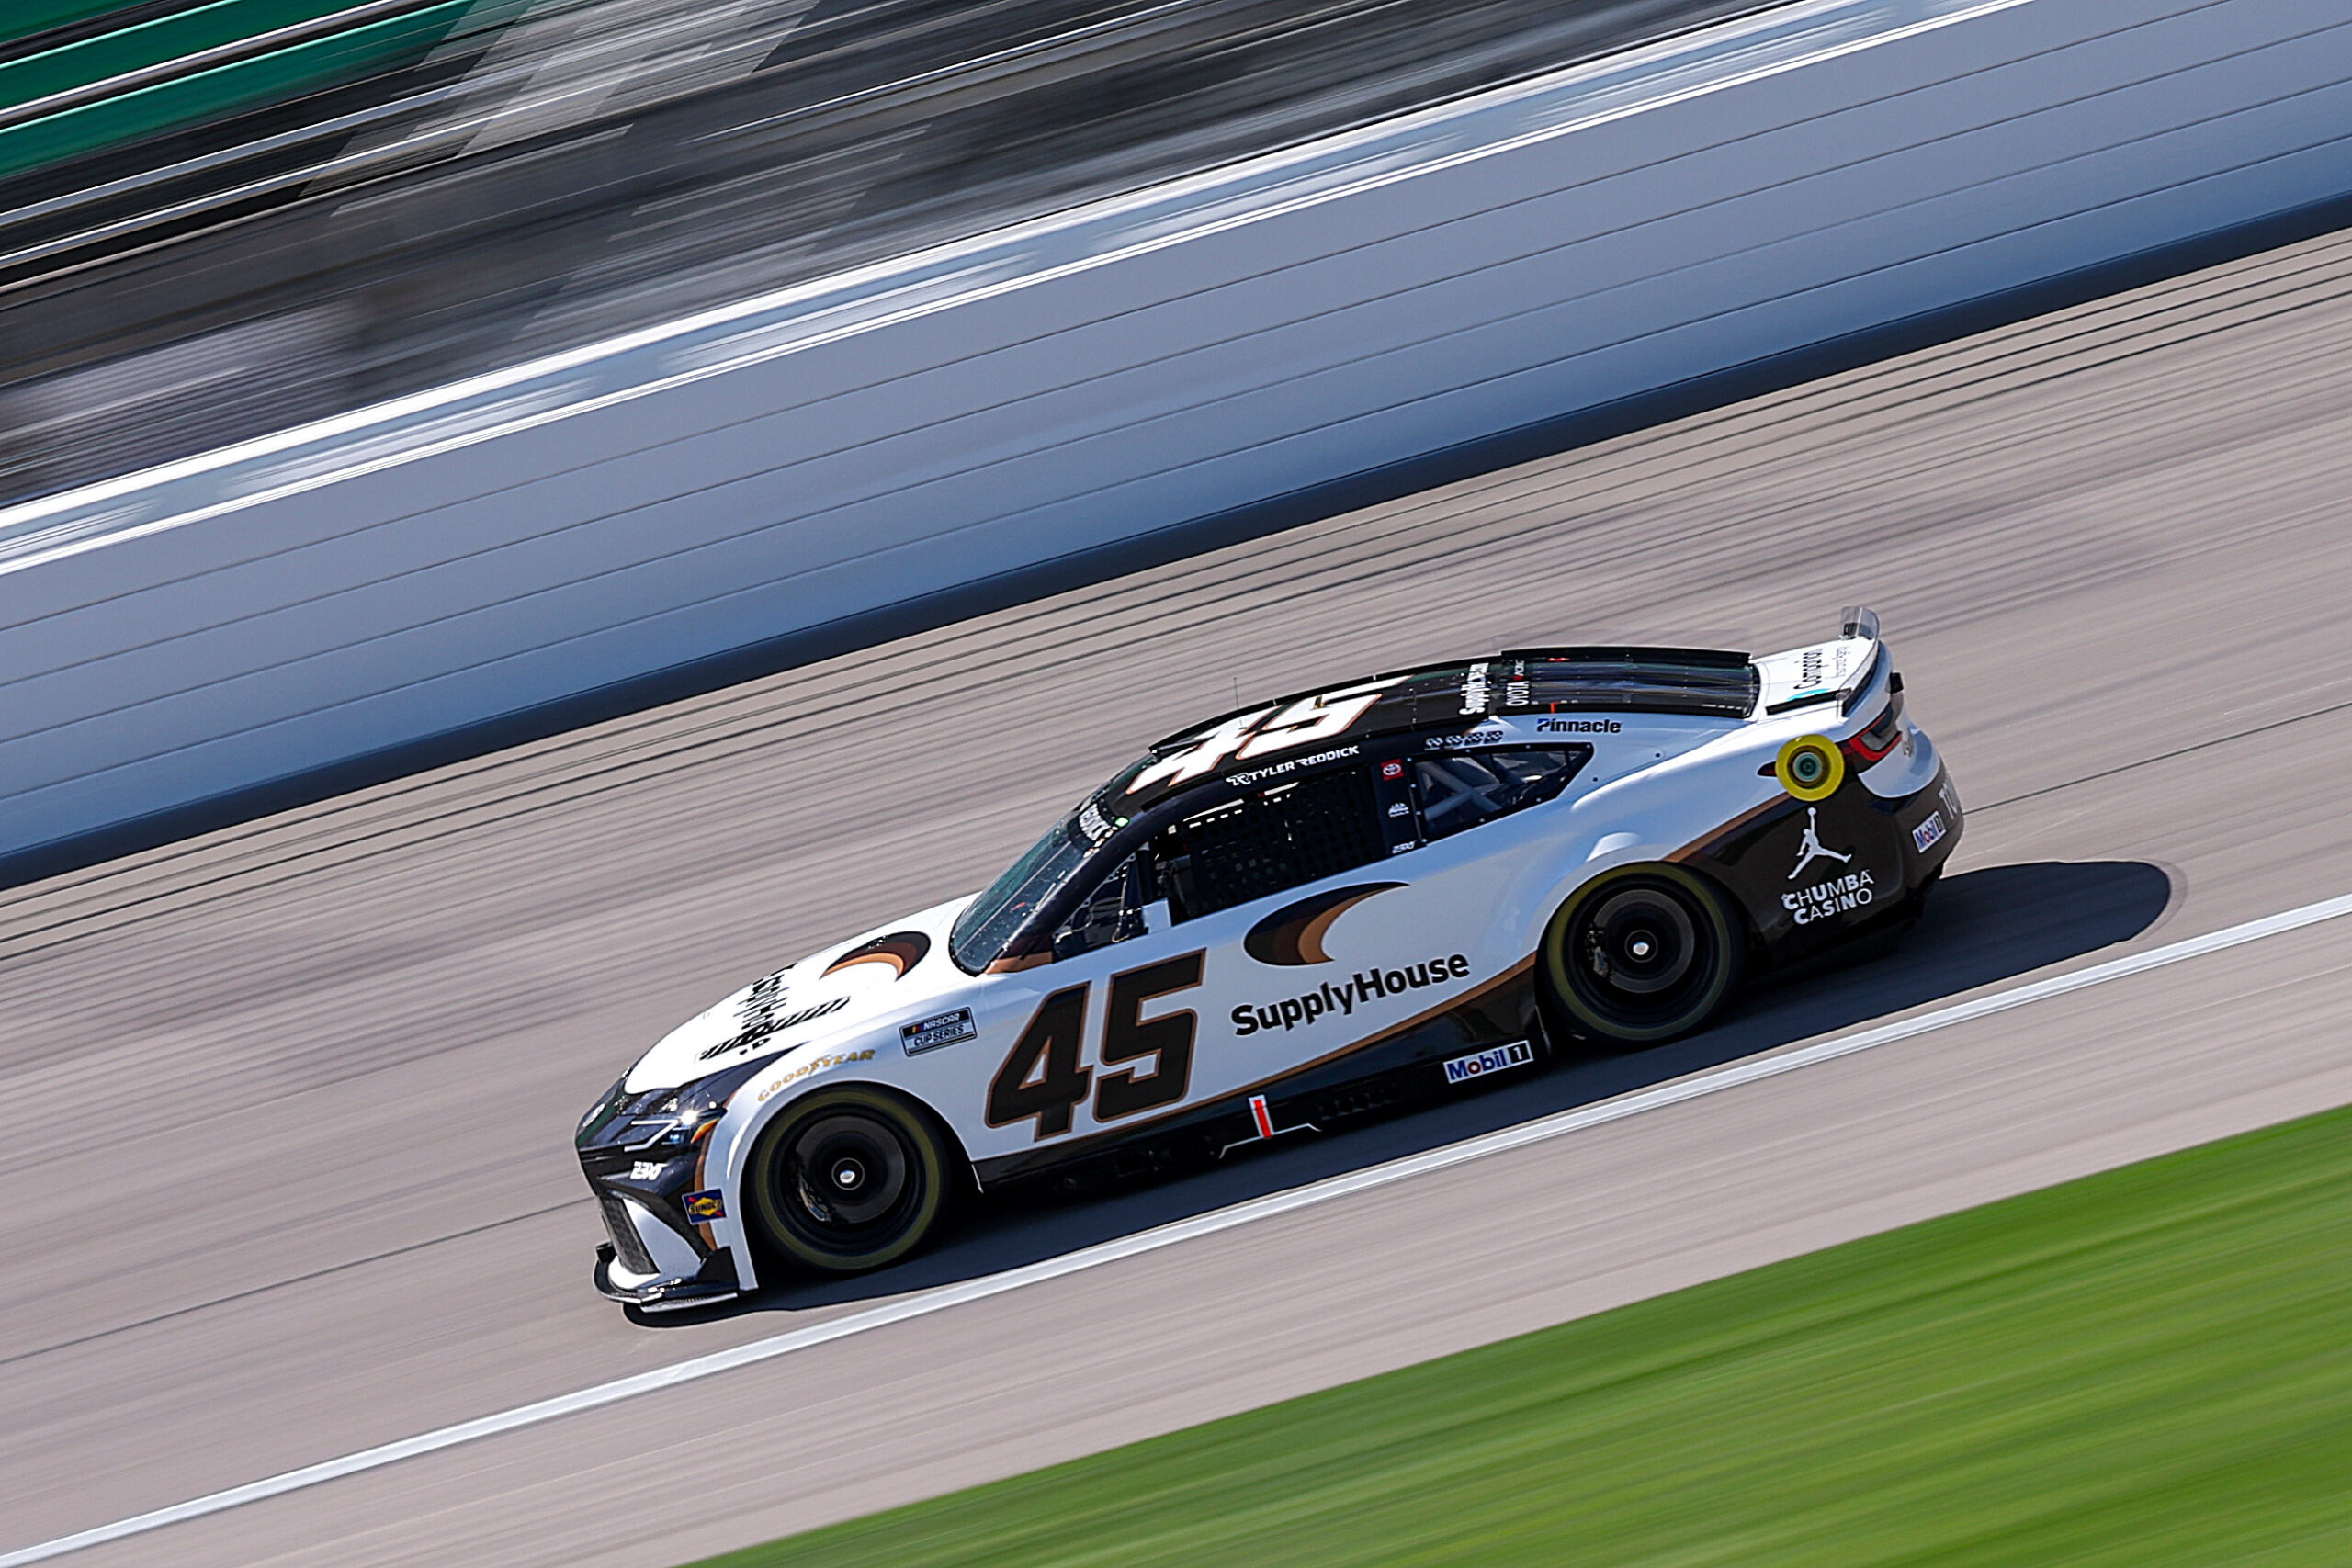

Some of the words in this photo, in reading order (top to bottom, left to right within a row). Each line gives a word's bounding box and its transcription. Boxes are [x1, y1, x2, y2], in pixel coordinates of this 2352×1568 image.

[1125, 675, 1413, 794] 45
[1536, 717, 1622, 734] Pinnacle
[1250, 761, 1295, 781] TYLER
[1295, 745, 1360, 766] REDDICK
[1781, 871, 1875, 910] CHUMBA
[1793, 888, 1873, 925] CASINO
[1231, 953, 1470, 1036] SupplyHouse
[913, 1033, 933, 1047] CUP
[933, 1024, 965, 1042] SERIES
[923, 1013, 961, 1029] NASCAR
[985, 948, 1206, 1142] 45
[757, 1049, 876, 1102] GOODYEAR
[1447, 1048, 1507, 1081] Mobil
[688, 1199, 723, 1215] SUNOCO
